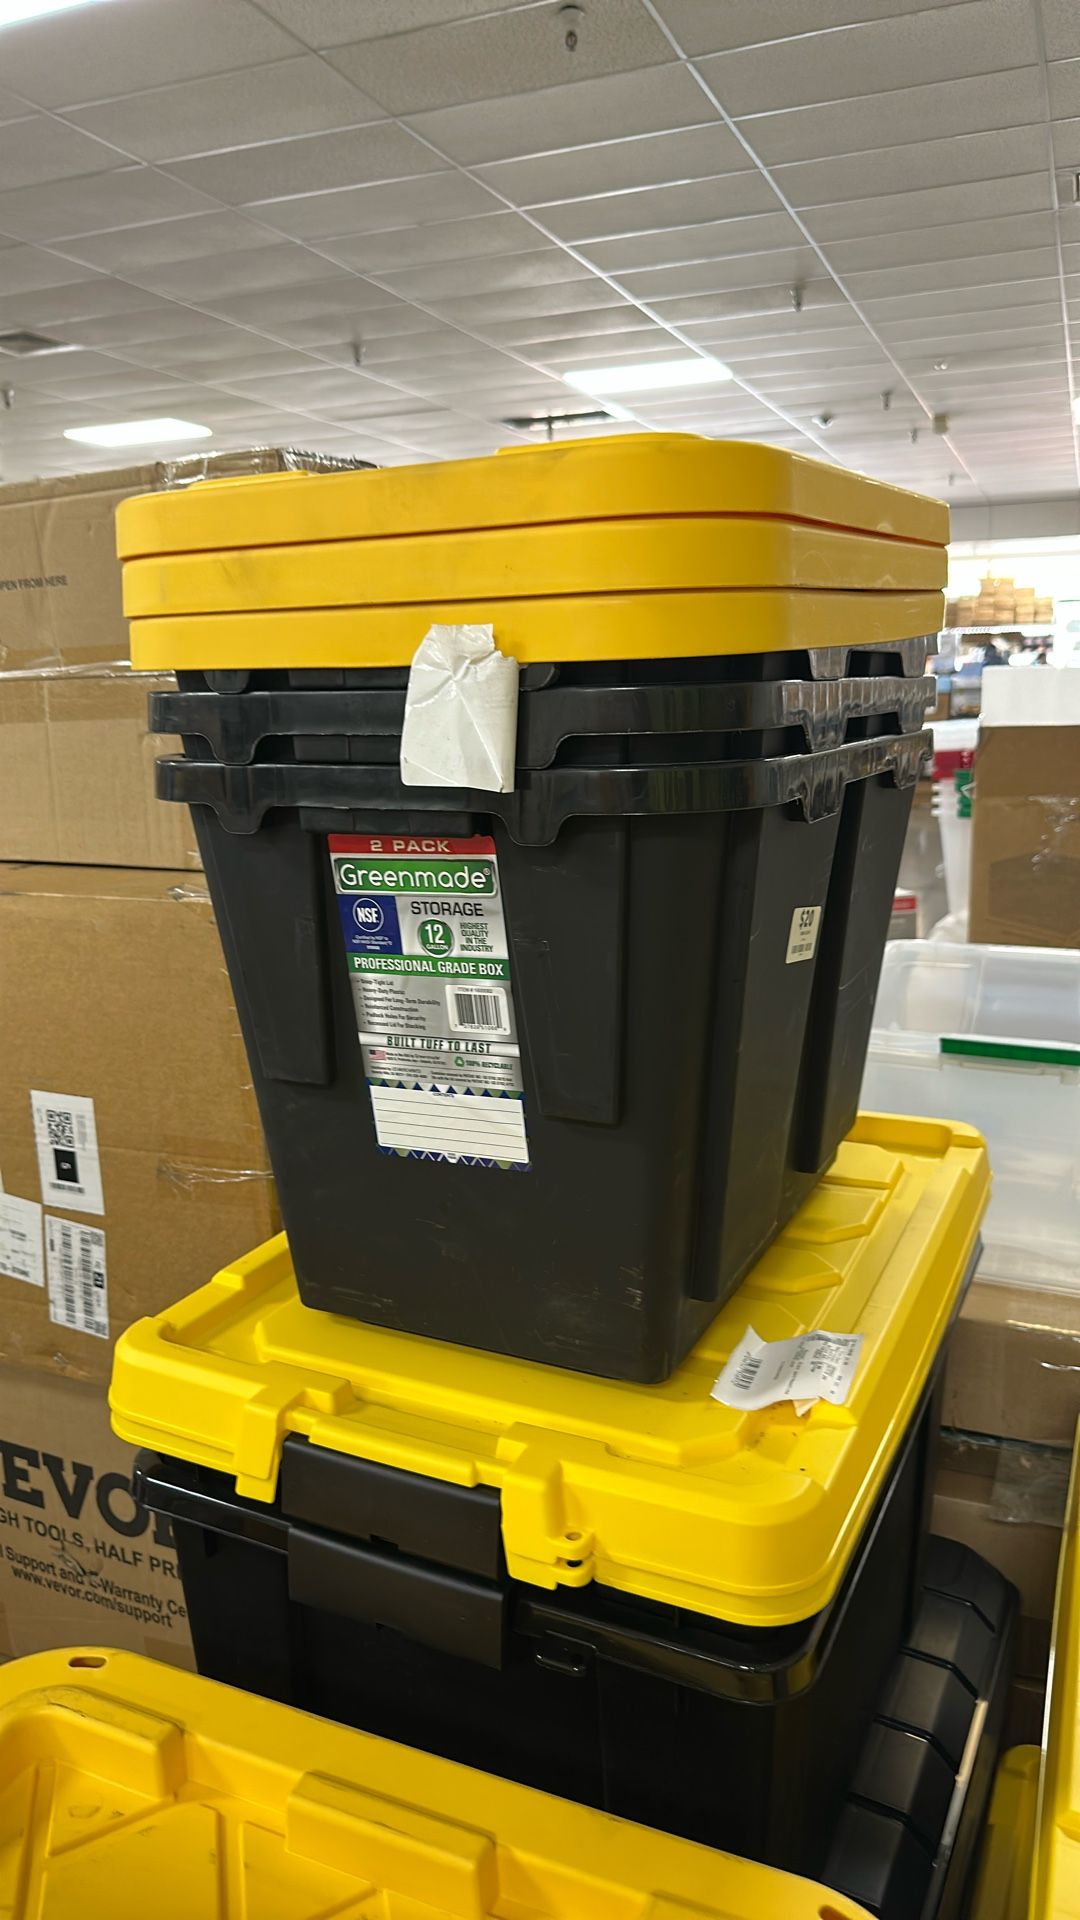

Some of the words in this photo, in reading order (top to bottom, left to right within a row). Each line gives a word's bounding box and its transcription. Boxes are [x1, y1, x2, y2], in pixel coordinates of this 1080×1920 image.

[45, 575, 68, 587] HERE
[370, 840, 383, 851] 2
[393, 841, 450, 852] PACK
[357, 907, 379, 923] NSF
[411, 902, 485, 916] STORAGE
[425, 924, 446, 944] 12
[461, 930, 489, 938] QUALITY
[460, 945, 493, 953] INDUSTRY
[354, 957, 436, 973] PROFESSIONAL
[438, 961, 477, 974] GRADE
[479, 963, 504, 976] BOX
[387, 1036, 416, 1047] BUILT
[420, 1038, 444, 1050] TUFF
[448, 1041, 460, 1051] TO
[465, 1042, 492, 1054] LAST
[481, 1062, 513, 1070] RECYCLABLE
[0, 1440, 177, 1549] EVO
[94, 1538, 143, 1568] HALF
[6, 1546, 57, 1575] Support
[60, 1568, 84, 1585] and
[11, 1566, 172, 1628] www.vevor.com/support
